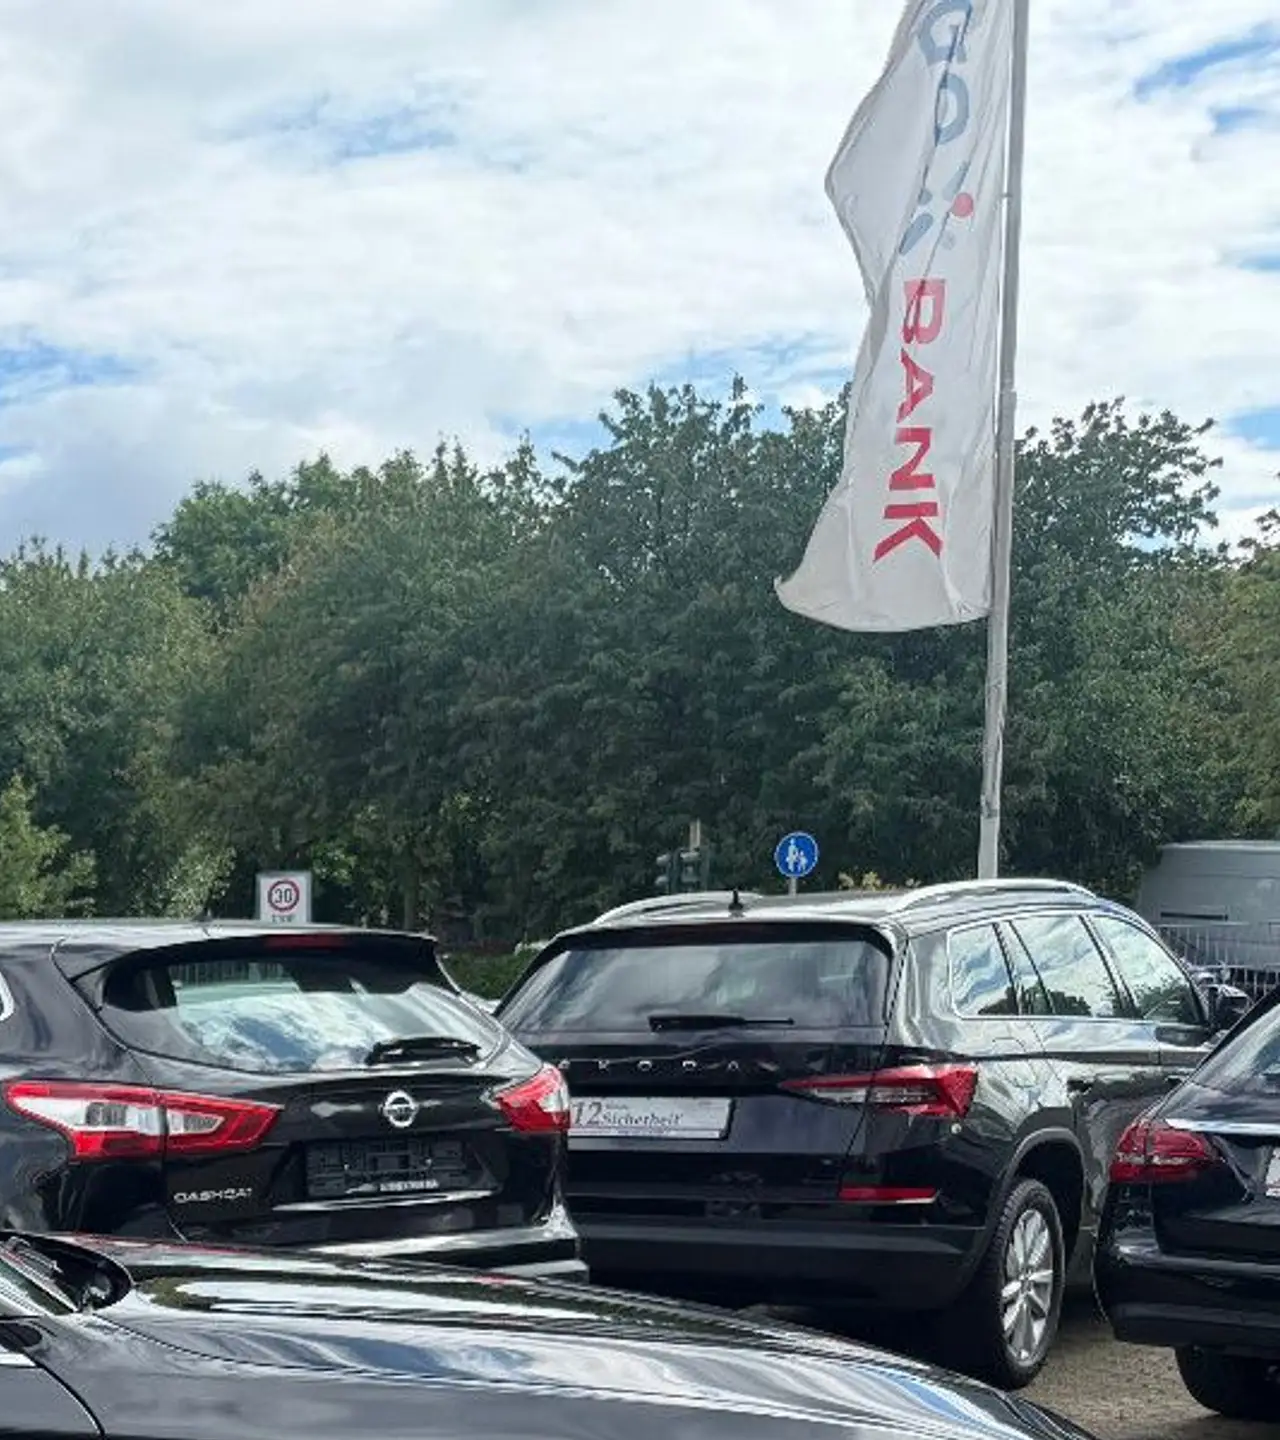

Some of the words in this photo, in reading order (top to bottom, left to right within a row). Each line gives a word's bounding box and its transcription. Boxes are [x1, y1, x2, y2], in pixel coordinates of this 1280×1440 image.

[873, 278, 944, 562] BANK
[274, 887, 293, 904] 30
[572, 1101, 602, 1127] 12
